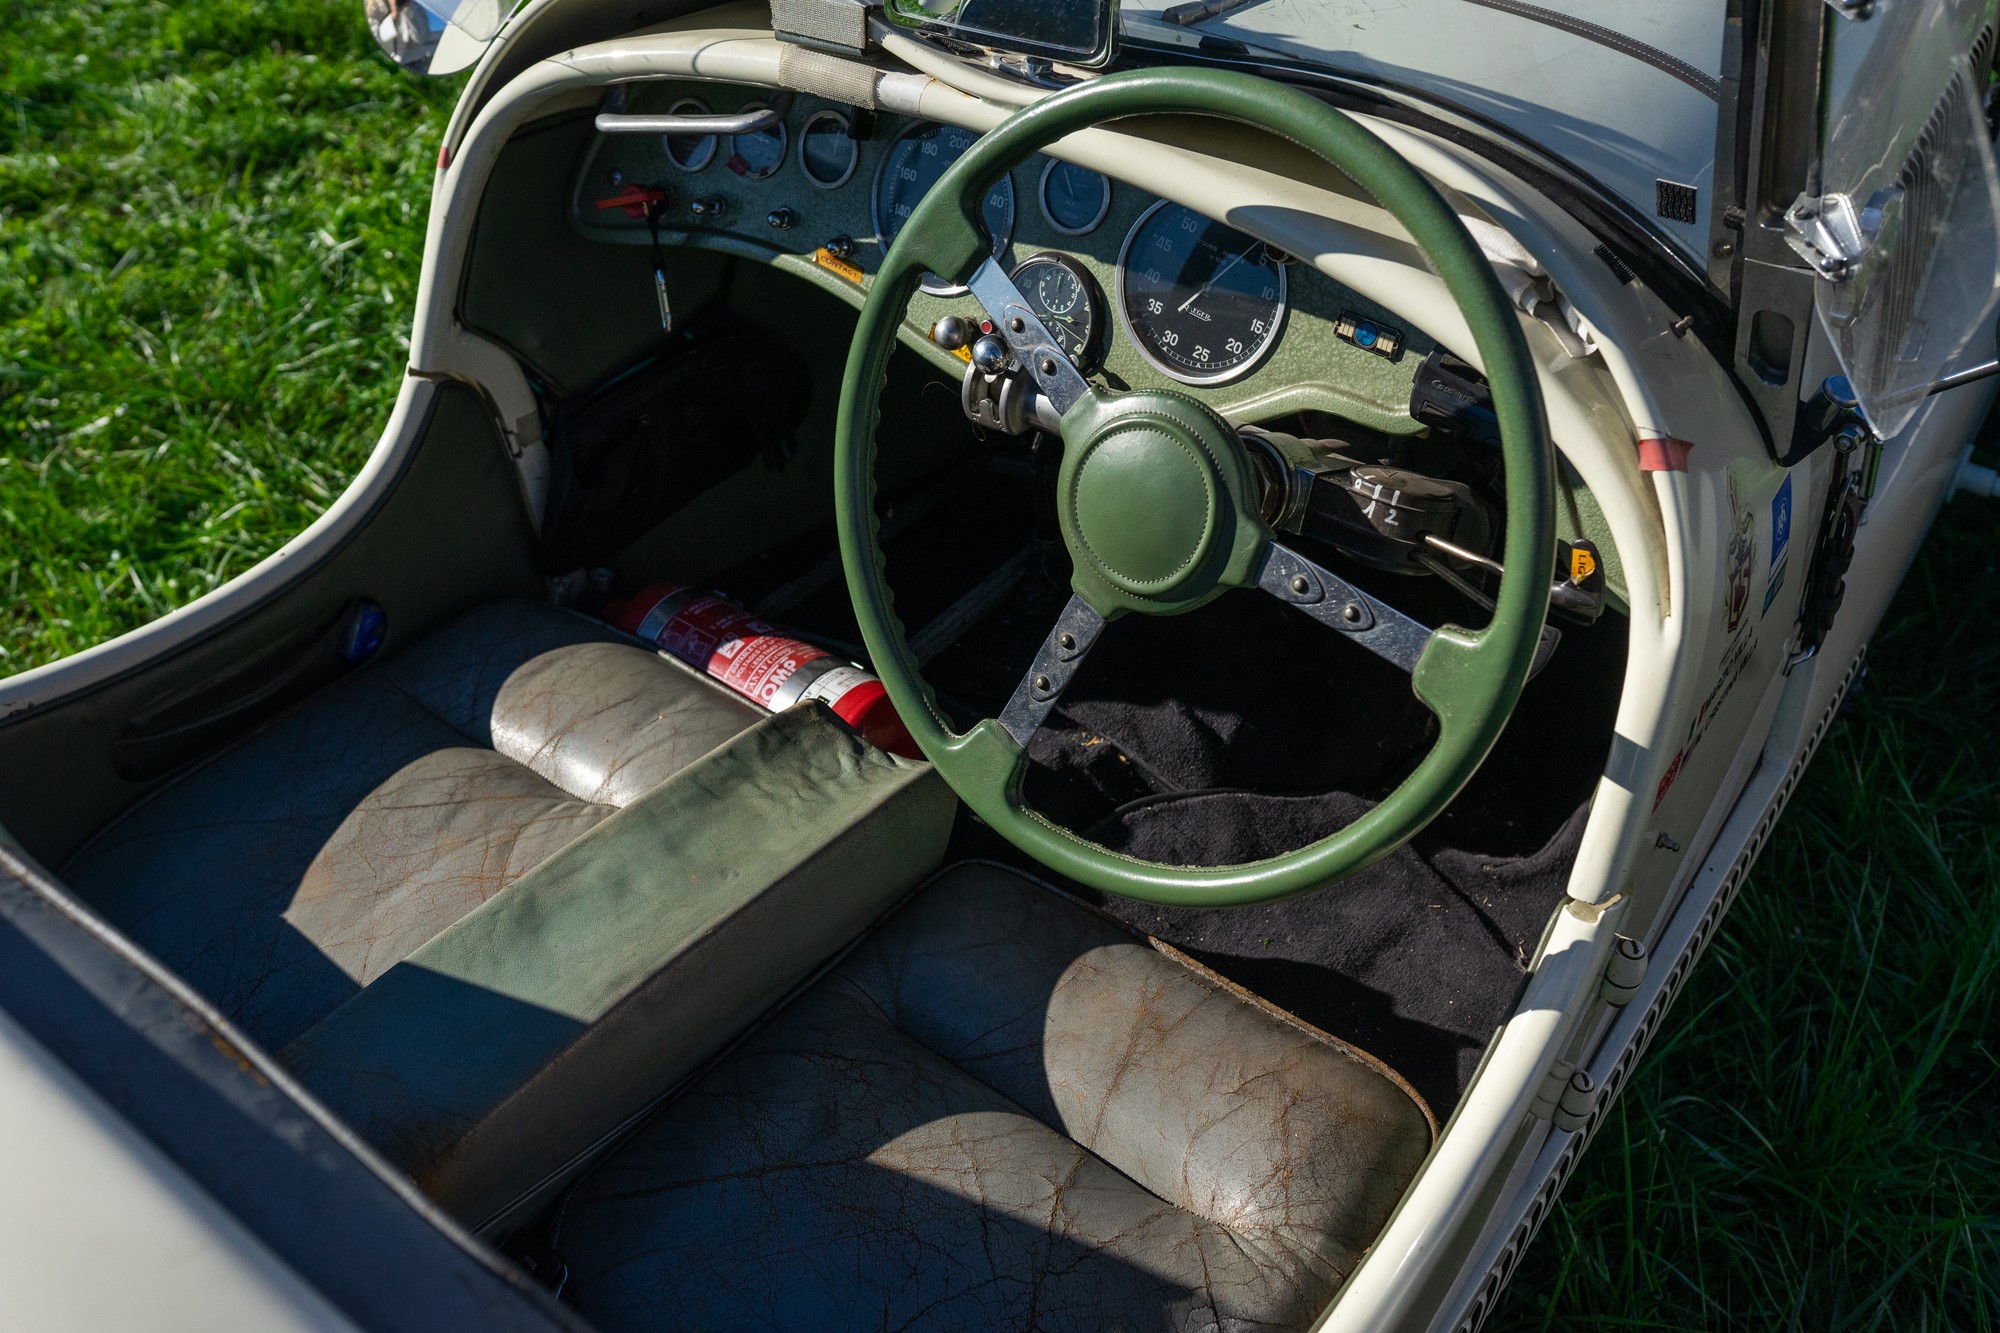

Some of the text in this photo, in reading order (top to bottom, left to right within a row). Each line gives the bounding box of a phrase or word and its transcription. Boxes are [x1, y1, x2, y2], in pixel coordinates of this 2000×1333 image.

[921, 142, 938, 156] 180
[948, 135, 970, 151] 200
[900, 167, 917, 181] 160
[990, 194, 1004, 208] 40
[894, 203, 911, 218] 140
[1181, 218, 1198, 233] 50
[1156, 235, 1173, 252] 45
[1199, 239, 1218, 252] TOURS
[820, 255, 857, 277] CONTACT
[1260, 252, 1267, 267] 5
[1144, 268, 1160, 283] 40
[1261, 285, 1275, 301] 10
[1147, 298, 1164, 315] 35
[1250, 318, 1265, 334] 15
[1162, 330, 1179, 347] 30
[1225, 338, 1243, 355] 20
[1192, 344, 1211, 362] 25
[1384, 508, 1399, 526] 2
[735, 649, 760, 678] VOLTAGES
[750, 654, 765, 668] LESS
[748, 662, 769, 688] ANAF
[761, 660, 796, 701] OMP
